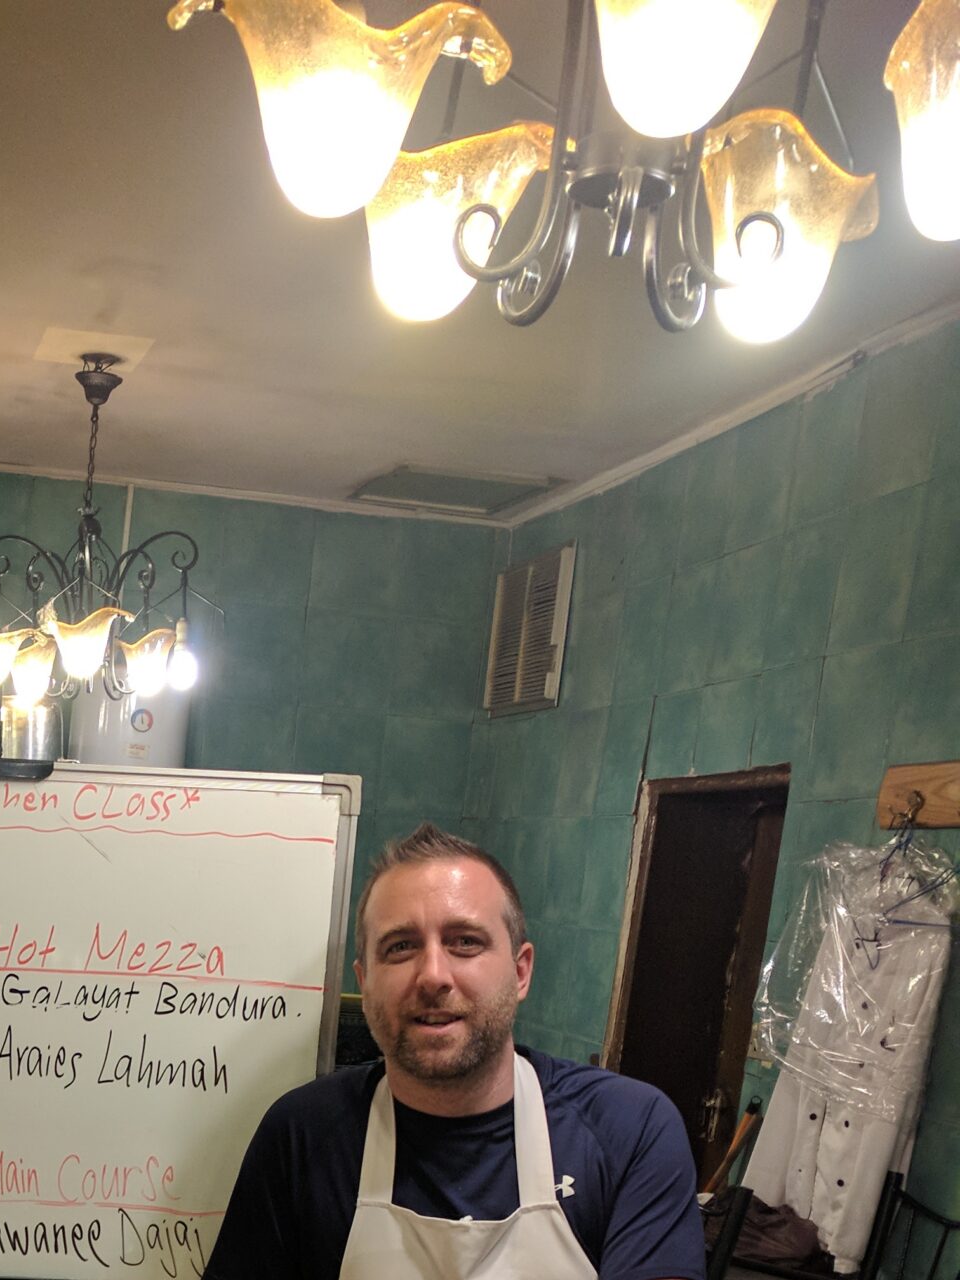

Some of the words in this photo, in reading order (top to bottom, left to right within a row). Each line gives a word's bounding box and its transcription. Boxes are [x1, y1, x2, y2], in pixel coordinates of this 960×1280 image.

[84, 922, 225, 977] Mezza
[154, 981, 303, 1022] Bandura.
[97, 1030, 228, 1094] Lahmah
[57, 1154, 182, 1202] Course
[118, 1208, 206, 1280] Dajaj
